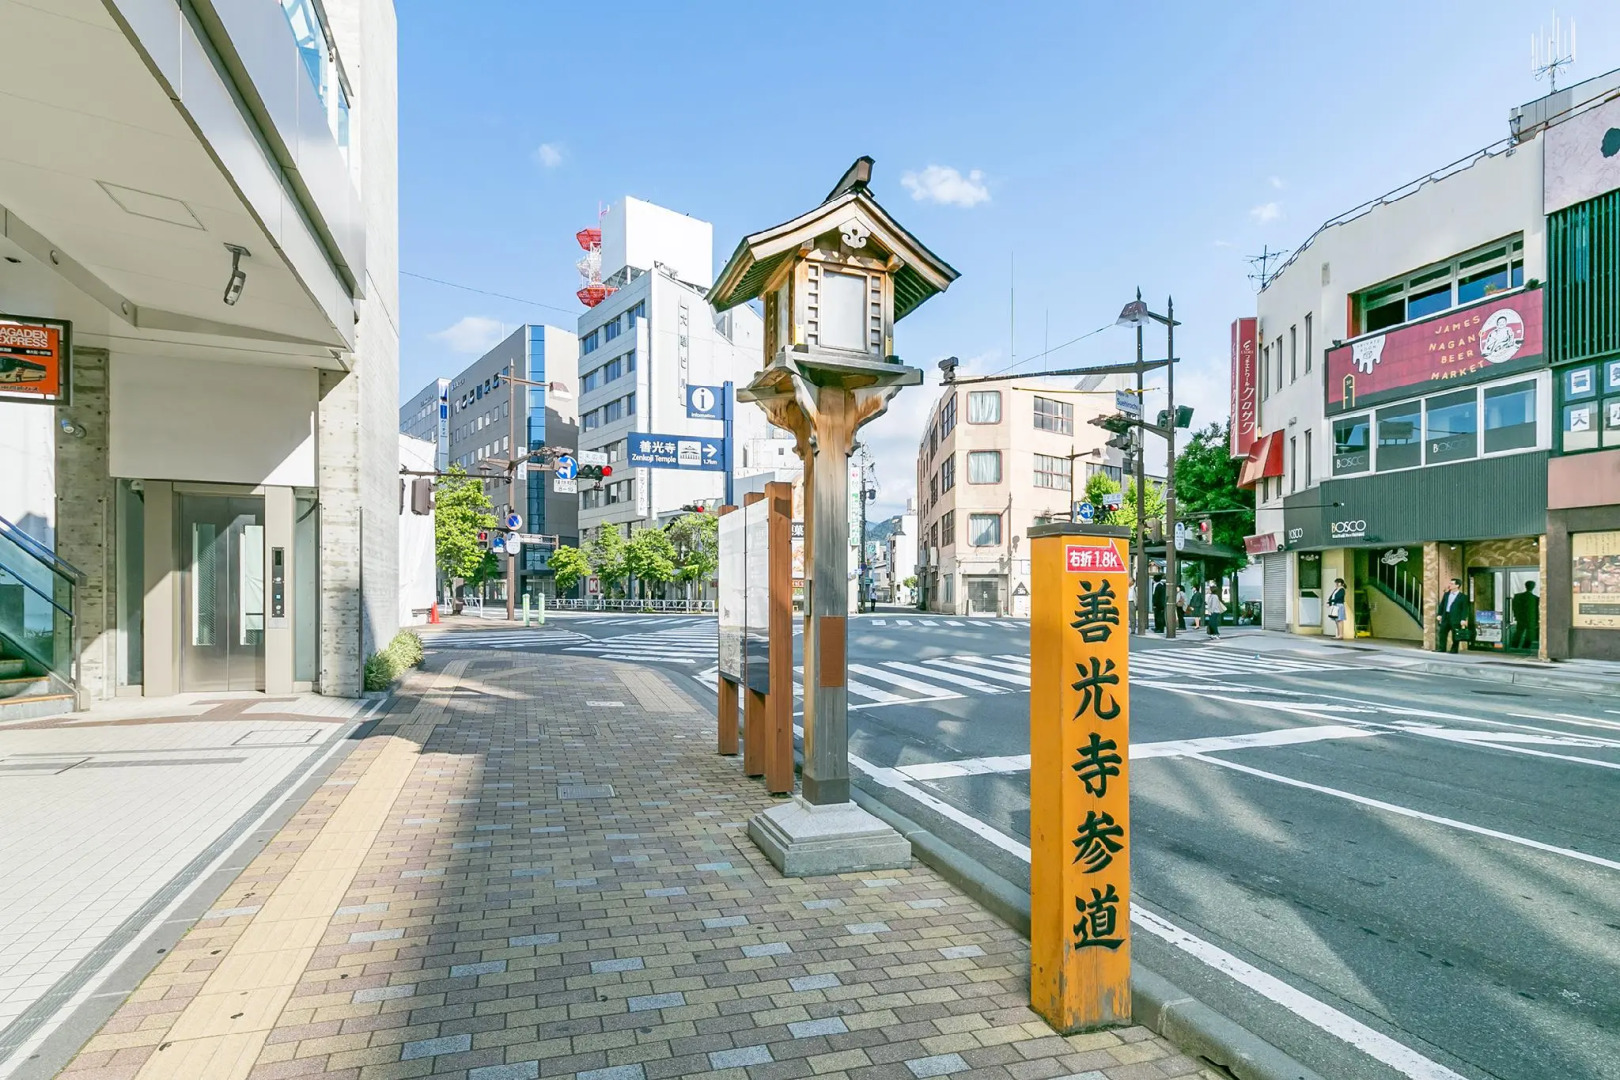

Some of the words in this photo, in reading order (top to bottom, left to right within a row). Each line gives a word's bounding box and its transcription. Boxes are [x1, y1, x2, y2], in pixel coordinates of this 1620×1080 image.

[1435, 315, 1480, 334] JAMES
[0, 336, 48, 348] EXPRESS
[1429, 329, 1485, 351] NAGANO
[1441, 350, 1474, 364] BEER
[1431, 360, 1484, 380] MARKET
[1240, 387, 1255, 435] クロサワ
[639, 440, 676, 454] 善光寺
[632, 454, 654, 463] Zenkoji
[655, 455, 676, 464] Temple
[1331, 519, 1366, 534] BOSCO
[1070, 579, 1126, 951] 善光寺参道
